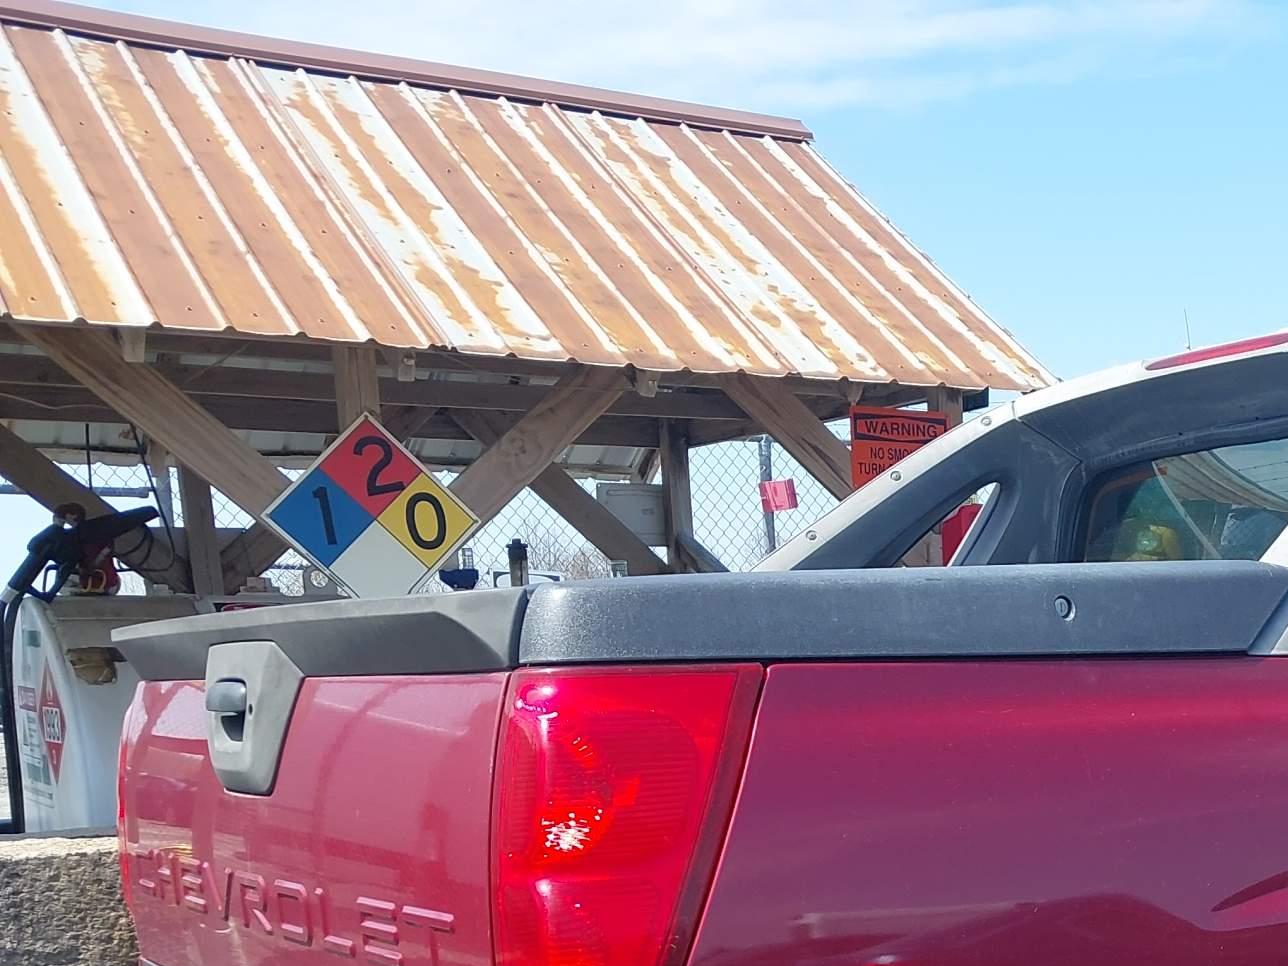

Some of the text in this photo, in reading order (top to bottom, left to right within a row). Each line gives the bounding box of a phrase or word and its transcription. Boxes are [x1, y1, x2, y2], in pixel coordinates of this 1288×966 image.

[865, 421, 938, 438] WARNING
[870, 447, 915, 461] NO SMO
[353, 436, 406, 497] 2
[312, 486, 338, 545] 1
[405, 491, 447, 550] 0
